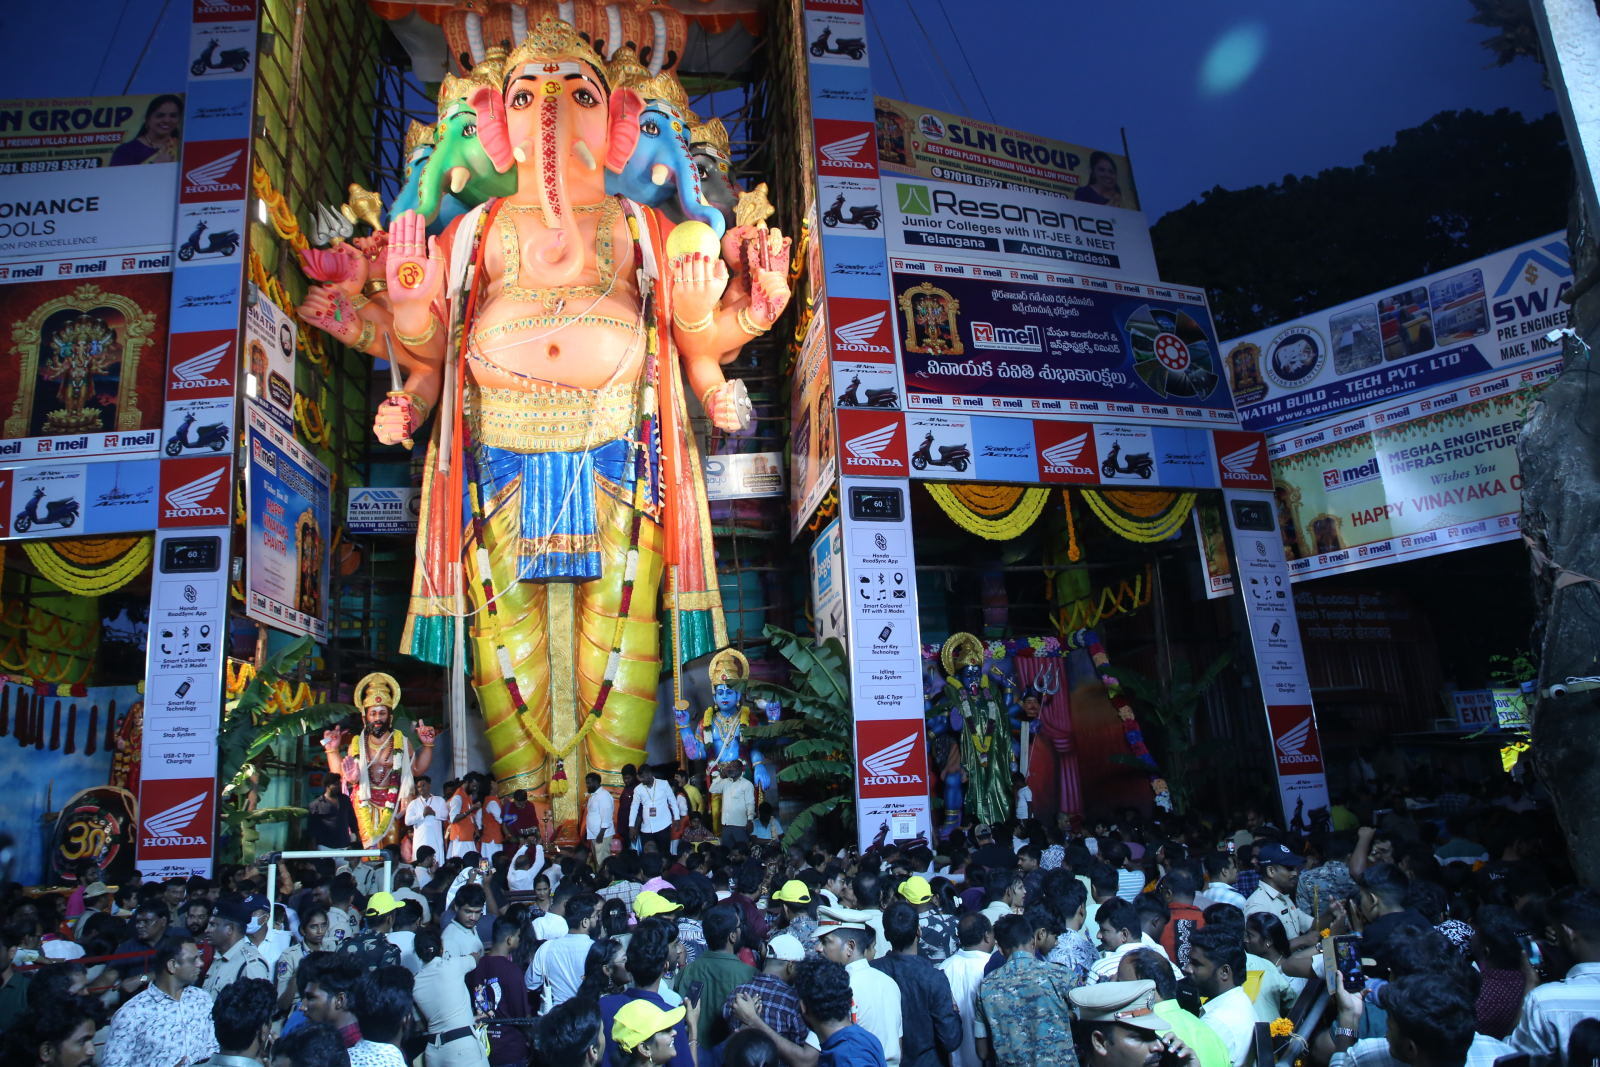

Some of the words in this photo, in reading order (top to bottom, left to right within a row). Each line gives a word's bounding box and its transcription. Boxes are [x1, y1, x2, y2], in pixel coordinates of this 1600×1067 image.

[197, 5, 252, 14] HONDA
[29, 106, 133, 132] GROUP
[42, 136, 68, 146] VILLAS
[78, 135, 95, 144] LOW
[95, 133, 121, 142] PRICES
[948, 123, 997, 153] SLN
[1000, 137, 1080, 171] GROUP
[22, 161, 59, 173] 88979
[62, 158, 97, 170] 93274
[821, 159, 875, 170] HONDA
[927, 144, 944, 155] BEST
[944, 148, 962, 159] OPEN
[962, 152, 981, 163] PLOTS
[988, 158, 1015, 169] PREMIUM
[1015, 163, 1036, 175] VILLAS
[1044, 170, 1057, 180] LOW
[943, 169, 973, 185] 97018
[185, 183, 242, 194] HONDA
[932, 189, 1115, 237] Resonance
[902, 215, 942, 229] Junior
[947, 219, 1002, 235] Colleges
[1005, 226, 1030, 238] with
[1033, 229, 1072, 244] IIT-JEE
[1075, 235, 1083, 246] &
[1086, 237, 1116, 251] NEET
[920, 232, 986, 250] Telangana
[18, 241, 38, 250] FOR
[39, 236, 98, 249] EXCELLENCE
[1020, 242, 1066, 260] Andhra
[1067, 249, 1111, 266] Pradesh
[12, 265, 43, 278] meil
[75, 260, 107, 273] meil
[138, 255, 170, 269] meil
[905, 262, 925, 271] meil
[983, 269, 1002, 278] meil
[1056, 276, 1074, 285] meil
[1123, 285, 1140, 294] meil
[996, 326, 1039, 345] meil
[1497, 324, 1518, 342] PRE
[835, 343, 891, 353] HONDA
[1500, 342, 1529, 361] MAKE,
[927, 360, 993, 378] వినాయక
[997, 361, 1035, 379] చవితి
[1038, 363, 1127, 388] శుభాకాంక్షలు
[1286, 389, 1326, 408] BUILD
[1345, 374, 1383, 393] TECH
[1387, 364, 1425, 383] PVT.
[1429, 353, 1461, 371] LTD
[171, 378, 231, 390] HONDA
[922, 395, 943, 406] meil
[1003, 399, 1023, 409] meil
[1079, 403, 1099, 411] meil
[1151, 407, 1169, 416] meil
[1217, 411, 1235, 420] meil
[1275, 378, 1416, 424] www.swathibuildtech.in
[1268, 444, 1286, 456] meil
[1343, 420, 1366, 434] meil
[1433, 393, 1459, 408] meil
[55, 437, 88, 451] meil
[121, 432, 155, 447] meil
[1388, 442, 1442, 463] MEGHA
[1444, 420, 1523, 449] ENGINEER
[262, 448, 276, 469] meil
[846, 457, 903, 467] HONDA
[1043, 465, 1095, 476] HONDA
[1223, 472, 1268, 481] HONDA
[1342, 458, 1381, 483] meil
[1430, 470, 1470, 486] Wishes
[1474, 463, 1497, 477] You
[165, 506, 226, 518] HONDA
[350, 502, 403, 510] SWATHI
[873, 500, 883, 508] 60
[1351, 501, 1404, 528] HAPPY
[1412, 479, 1507, 513] VINAYAKA
[1291, 559, 1310, 571] meil
[1370, 542, 1391, 555] meil
[1461, 522, 1487, 537] meil
[1461, 706, 1492, 723] EXIT
[1279, 755, 1319, 764] HONDA
[863, 775, 923, 786] HONDA
[143, 836, 207, 847] HONDA
